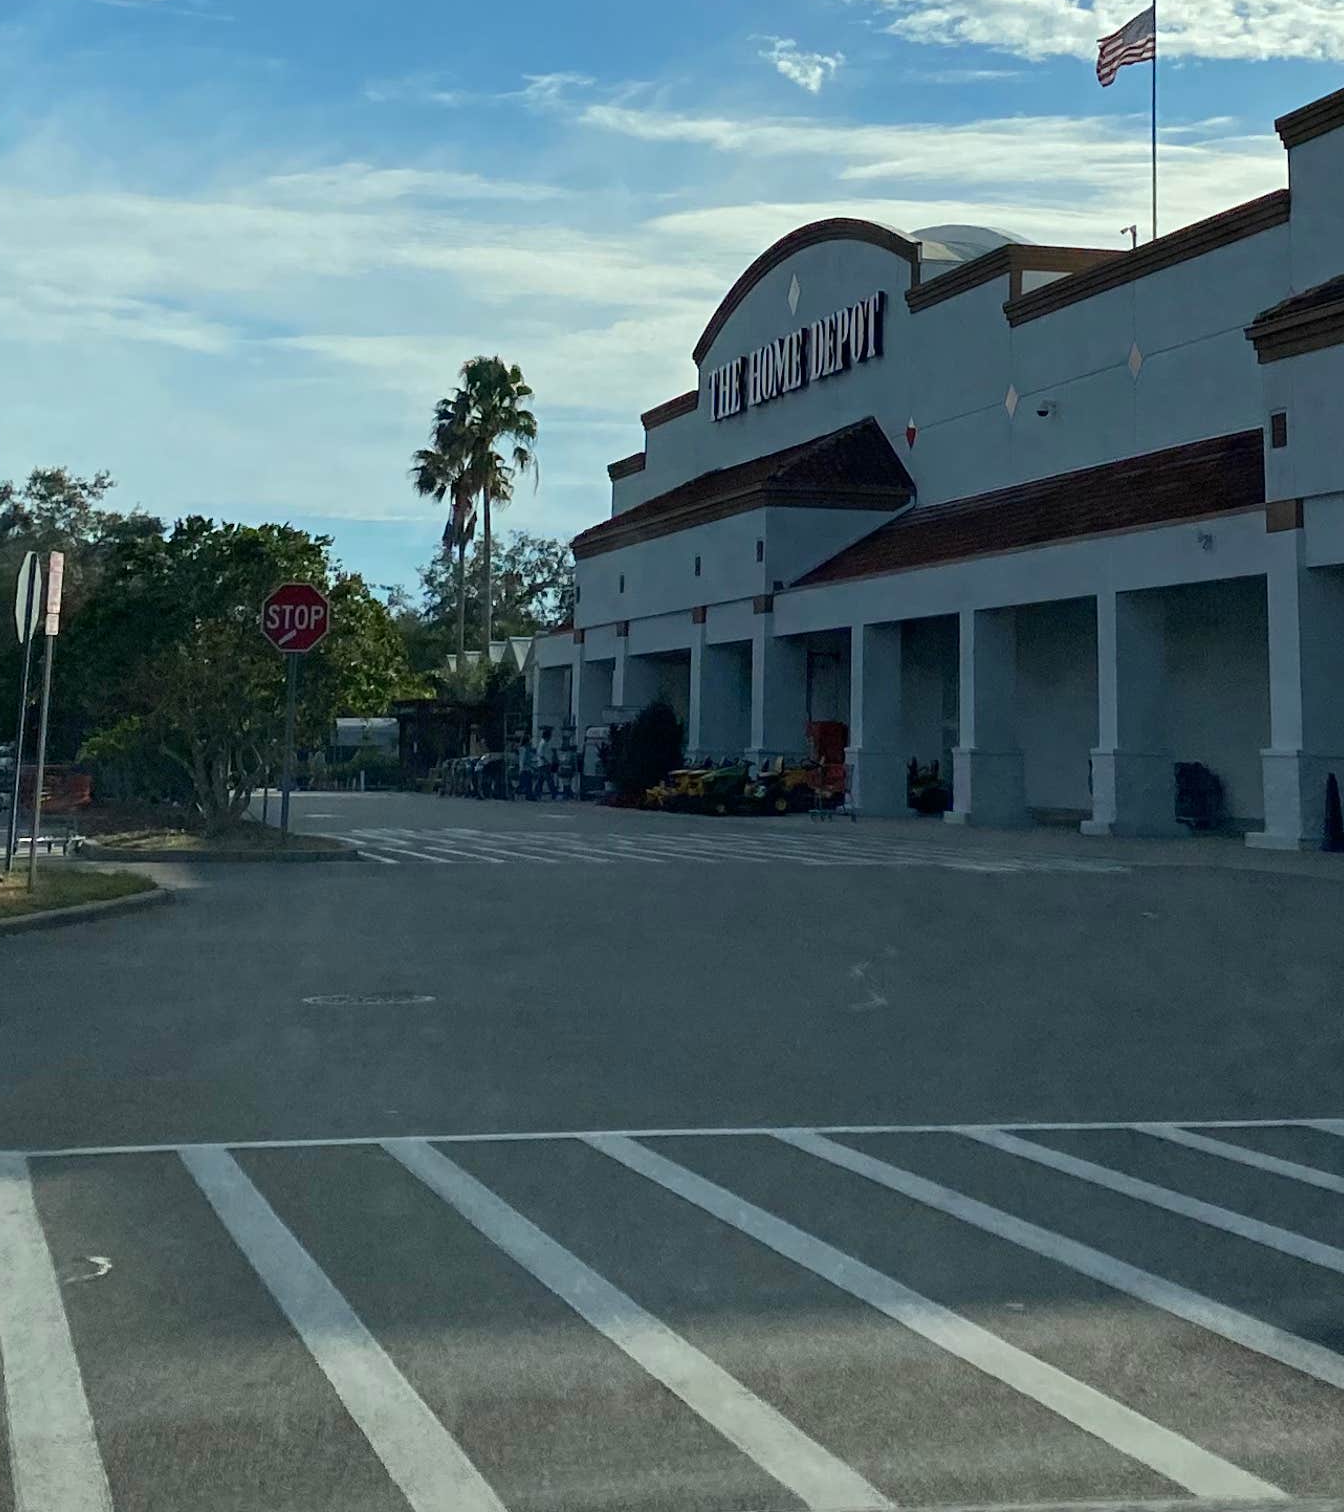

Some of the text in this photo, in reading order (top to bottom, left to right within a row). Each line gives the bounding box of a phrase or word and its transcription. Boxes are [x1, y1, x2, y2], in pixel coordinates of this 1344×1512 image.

[709, 291, 883, 422] THE HOME DEPOT
[266, 604, 324, 629] STOP
